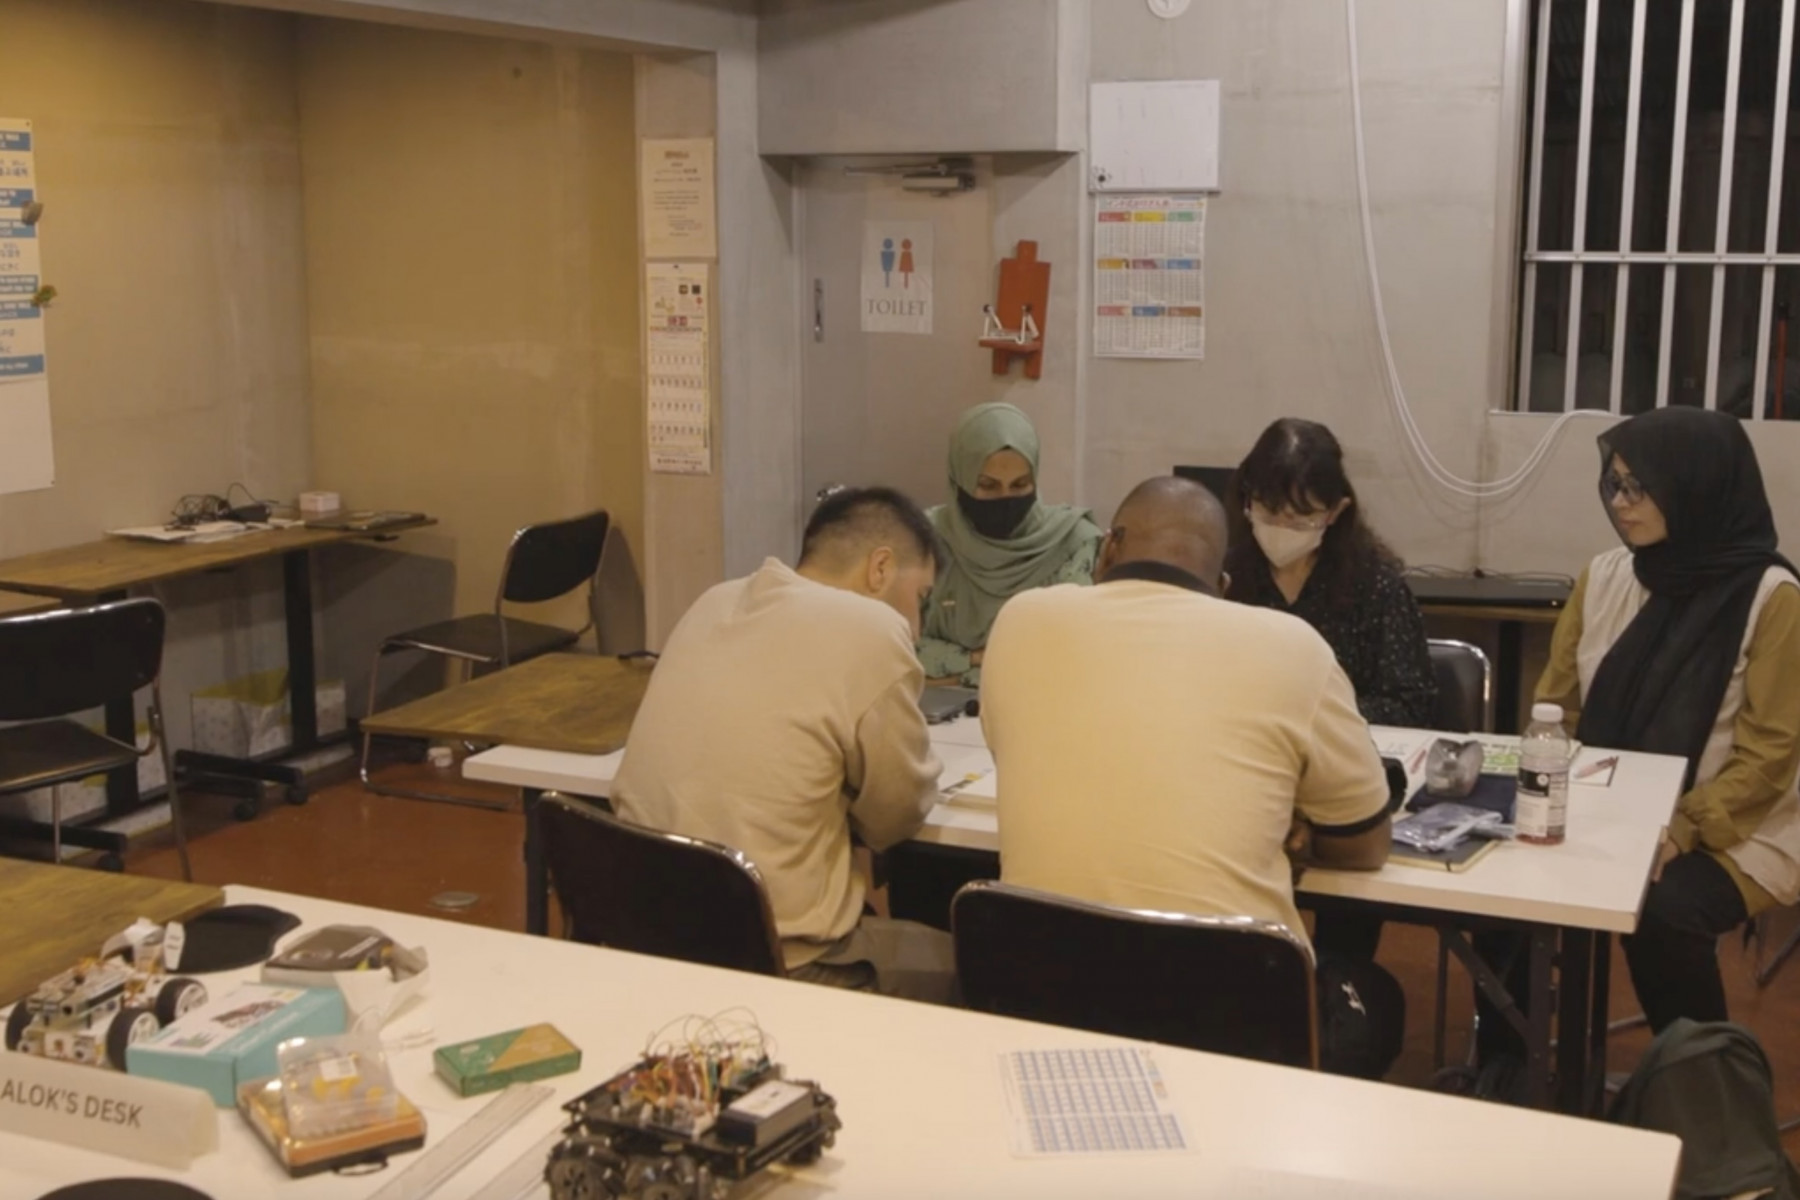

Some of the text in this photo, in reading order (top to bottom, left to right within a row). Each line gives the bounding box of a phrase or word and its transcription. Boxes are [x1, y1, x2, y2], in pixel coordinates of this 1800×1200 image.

[866, 299, 928, 316] TOILET
[0, 1079, 143, 1128] ALOK'S DESK
